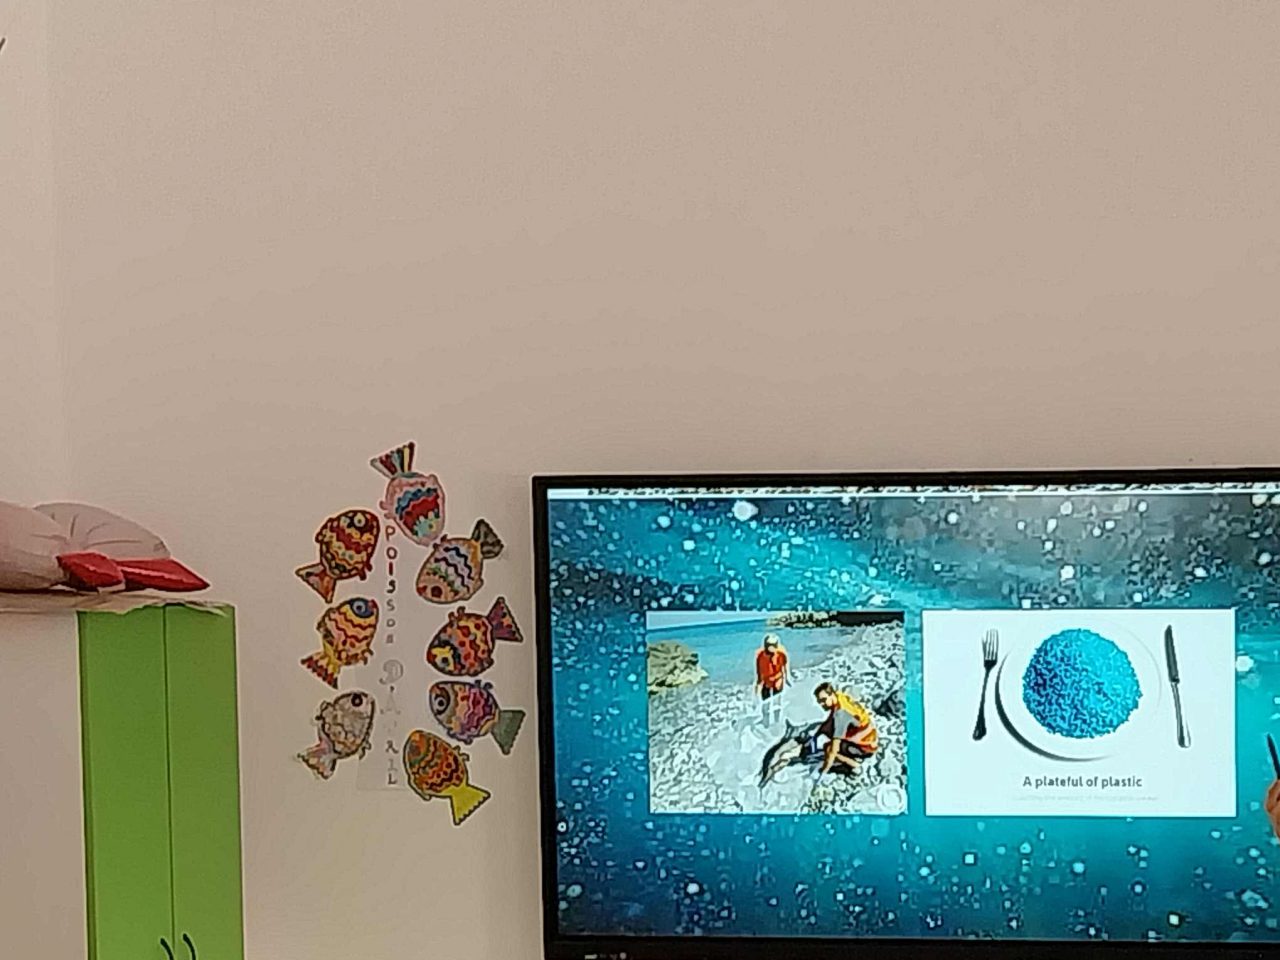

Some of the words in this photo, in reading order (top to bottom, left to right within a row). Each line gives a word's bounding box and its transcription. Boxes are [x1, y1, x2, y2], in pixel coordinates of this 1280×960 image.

[1023, 776, 1032, 787] A
[1035, 776, 1083, 789] plateful
[1086, 776, 1098, 787] of
[1101, 775, 1143, 789] plastic
